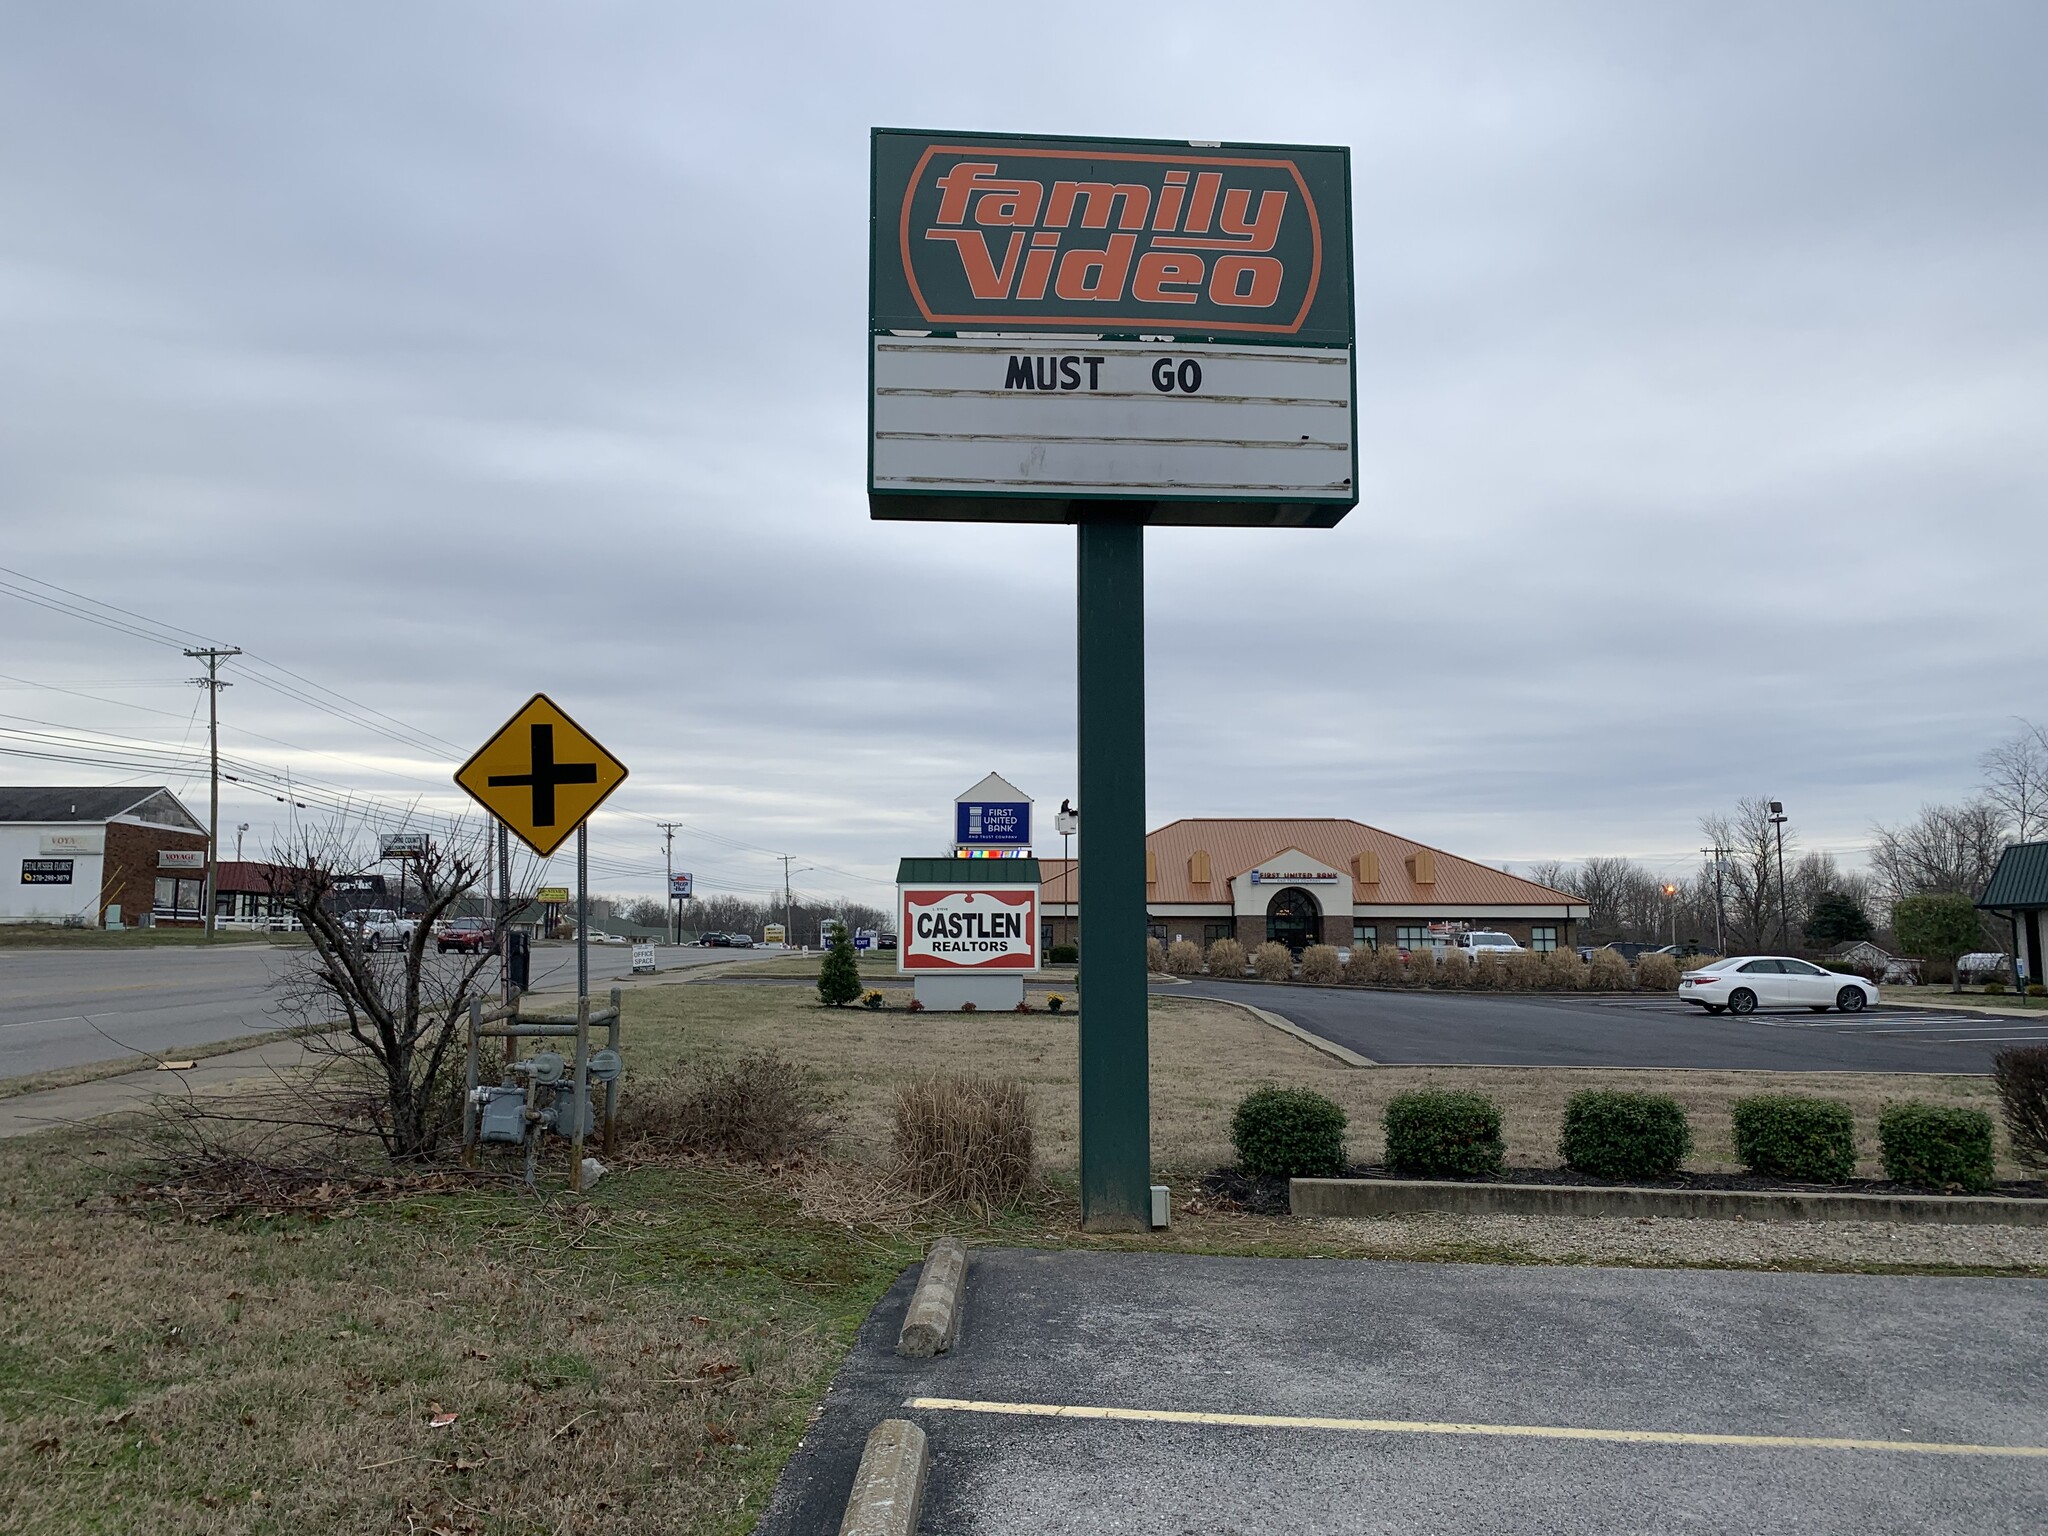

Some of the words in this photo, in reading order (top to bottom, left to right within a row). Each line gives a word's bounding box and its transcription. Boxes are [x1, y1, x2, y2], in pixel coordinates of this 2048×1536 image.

[936, 162, 1289, 252] family
[925, 228, 1285, 308] Video
[1004, 355, 1105, 390] MUST
[1151, 358, 1202, 393] GO
[989, 808, 1013, 816] FIRST
[983, 816, 1018, 825] UNITED
[988, 824, 1014, 832] BANK
[51, 837, 77, 845] VOYA
[23, 861, 37, 871] PETAL
[37, 861, 53, 871] PUSHER
[54, 861, 73, 871] FLORIST
[917, 912, 1021, 939] CASTLEN
[932, 941, 1008, 952] REALTORS
[634, 957, 653, 965] SPACE
